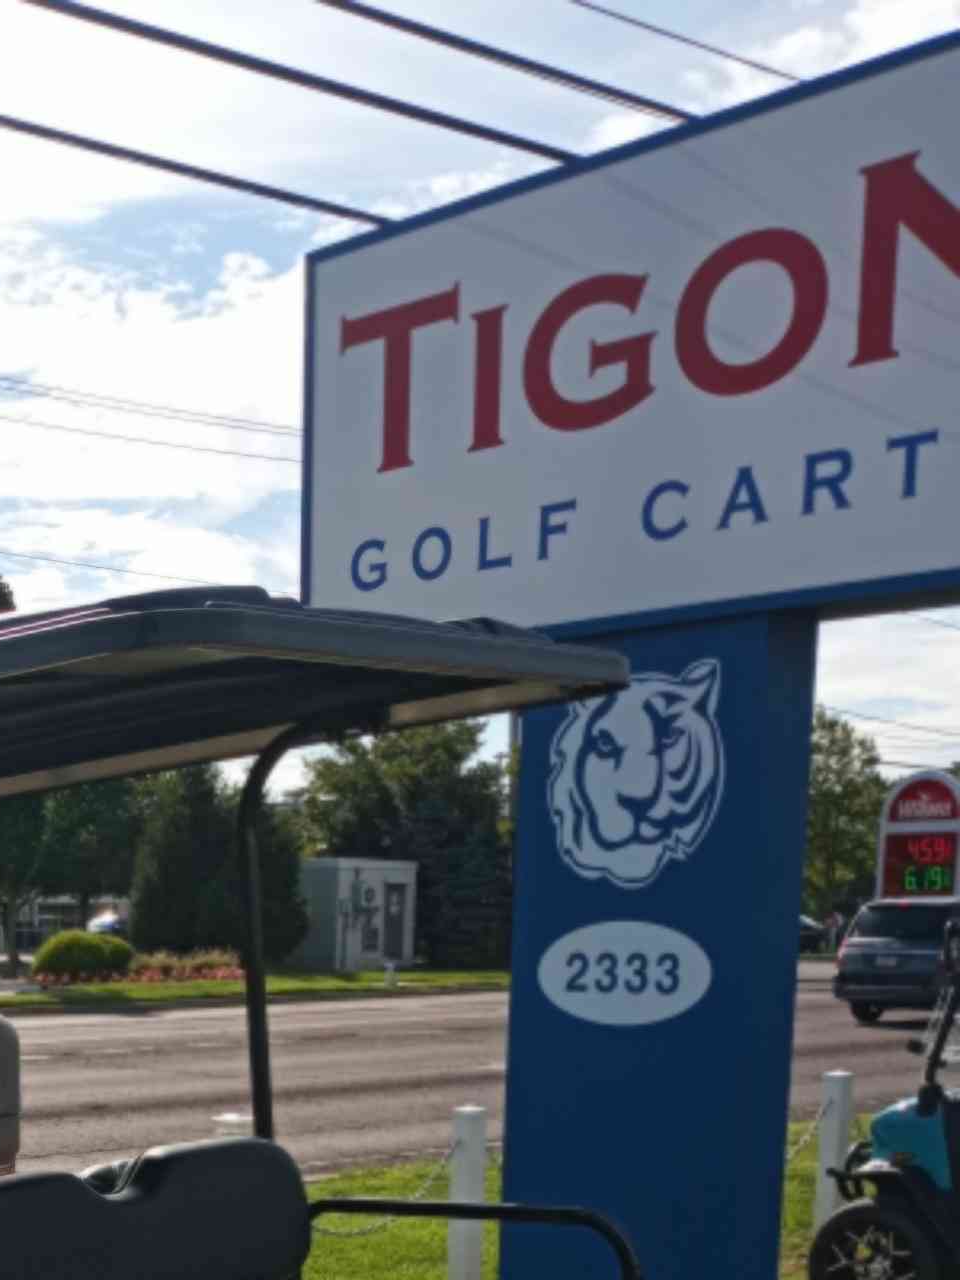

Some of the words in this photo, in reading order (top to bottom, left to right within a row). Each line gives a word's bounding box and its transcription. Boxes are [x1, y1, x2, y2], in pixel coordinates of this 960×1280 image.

[350, 499, 577, 591] GOLF
[641, 429, 939, 541] CART
[565, 953, 681, 995] 2333
